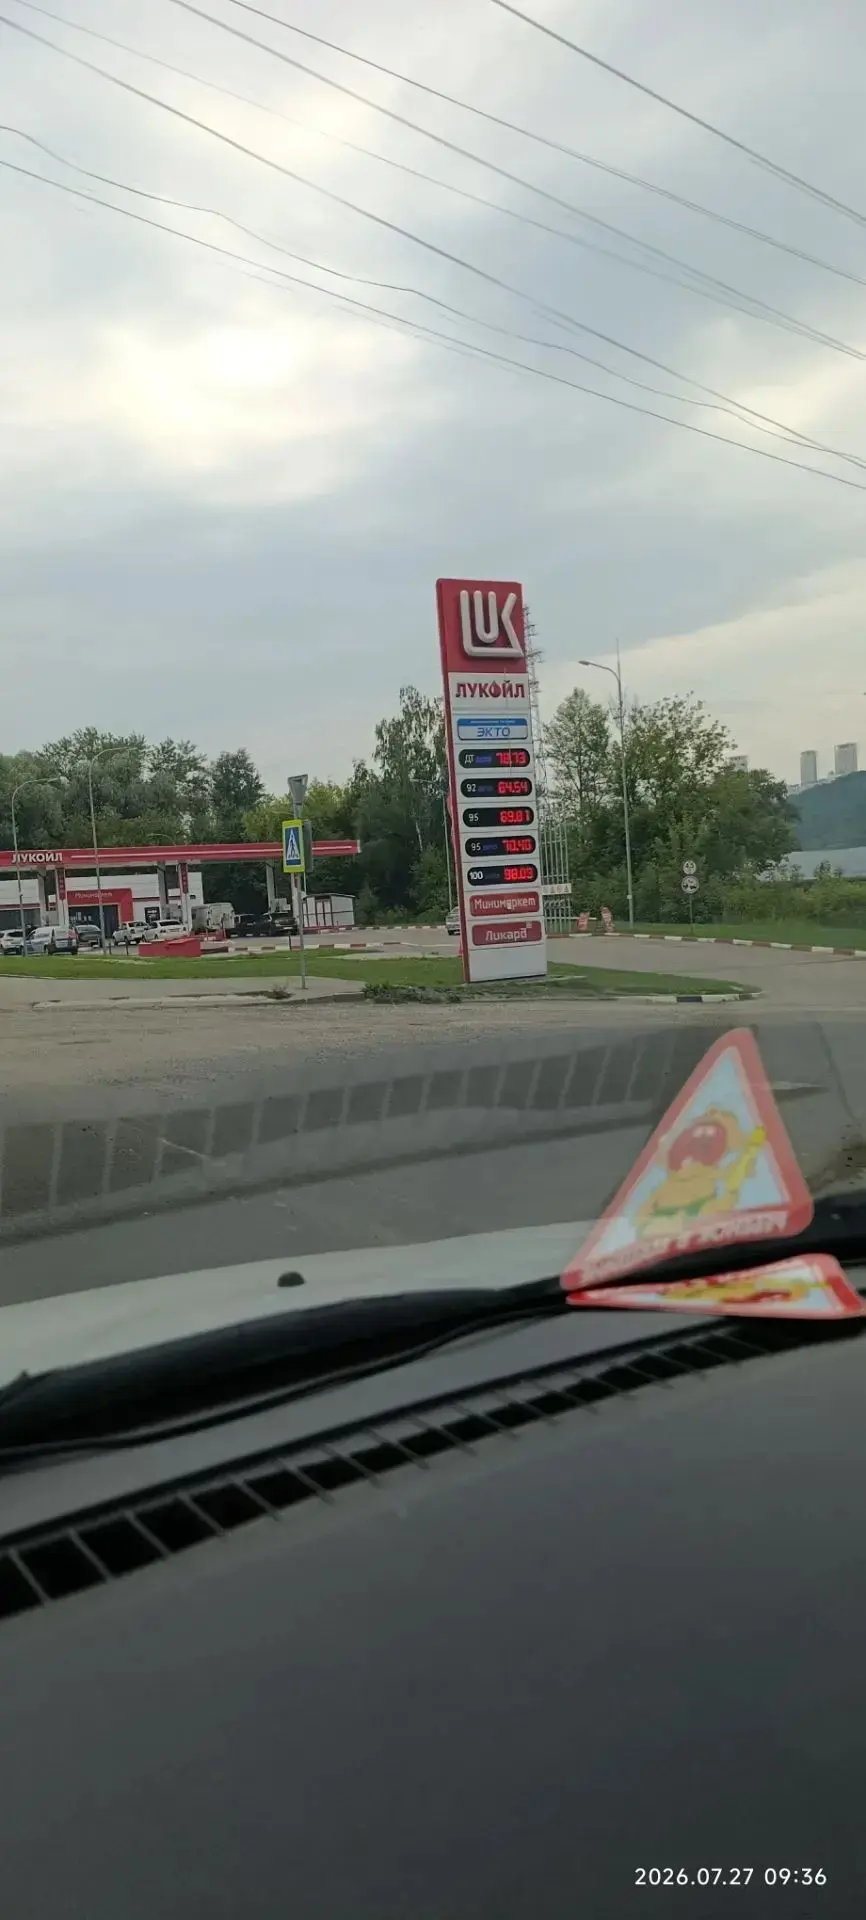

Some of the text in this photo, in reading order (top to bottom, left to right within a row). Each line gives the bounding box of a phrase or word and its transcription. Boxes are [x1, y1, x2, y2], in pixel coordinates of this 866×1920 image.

[456, 680, 525, 698] ЛУКОЙЛ
[477, 727, 511, 737] ЭКТО
[464, 754, 474, 764] ДТ
[466, 783, 477, 792] 92
[498, 781, 528, 794] 64.54
[468, 812, 479, 822] 95
[470, 842, 481, 851] 95
[12, 852, 63, 863] ЛУКОЙЛ
[469, 871, 483, 880] 100
[485, 928, 527, 941] Ликард
